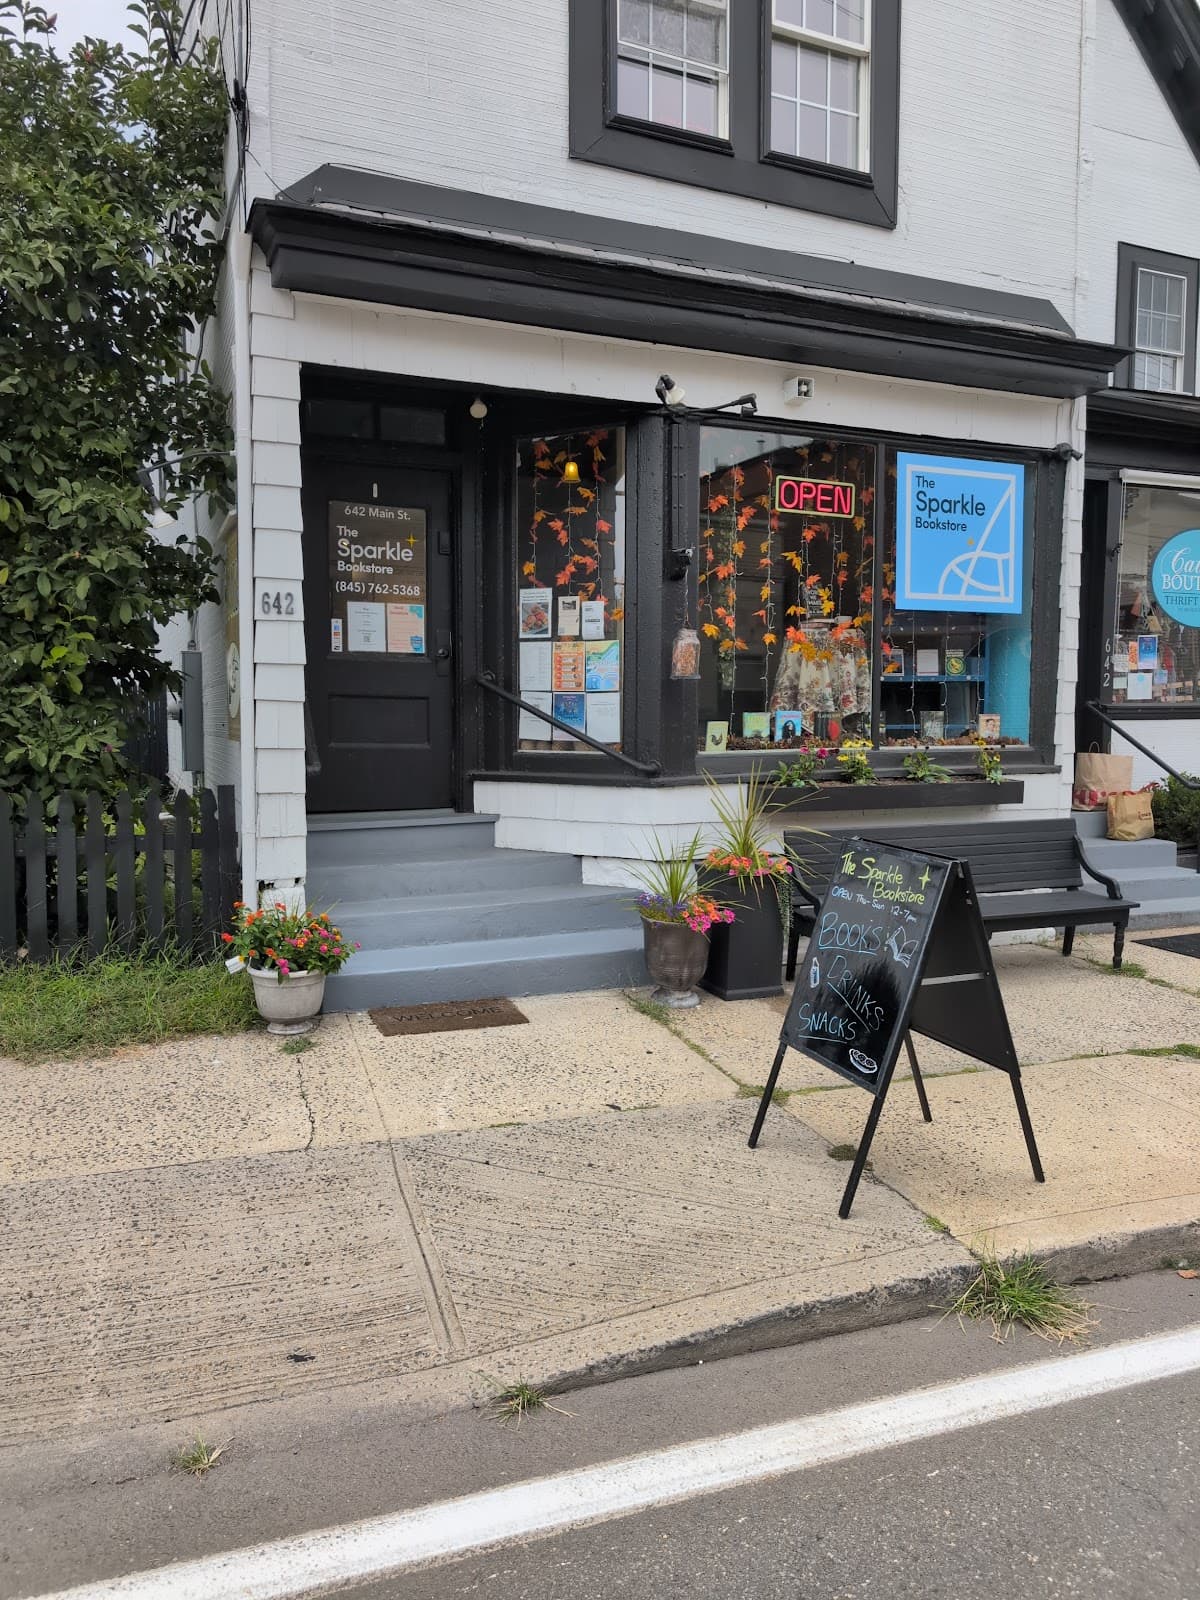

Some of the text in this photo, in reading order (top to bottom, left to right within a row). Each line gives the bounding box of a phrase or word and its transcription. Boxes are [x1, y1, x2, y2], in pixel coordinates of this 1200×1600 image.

[915, 475, 936, 489] The
[779, 480, 852, 514] OPEN
[915, 490, 986, 518] Sparkle
[344, 505, 411, 521] 642 Main St.
[336, 525, 359, 537] The
[915, 516, 967, 532] Bookstore
[337, 538, 414, 563] Sparkle
[337, 560, 394, 575] Bookstore
[335, 580, 421, 597] (845) 762-5368
[261, 591, 295, 615] 642
[1163, 595, 1198, 606] THRIFT
[841, 851, 904, 888] The Sparkle
[831, 885, 853, 901] OPEN
[872, 881, 925, 905] Bookstore
[818, 912, 883, 952] BOOKS
[827, 955, 885, 1032] DRINKS
[392, 1006, 505, 1023] WELCOME
[798, 1003, 858, 1041] SNACKS
